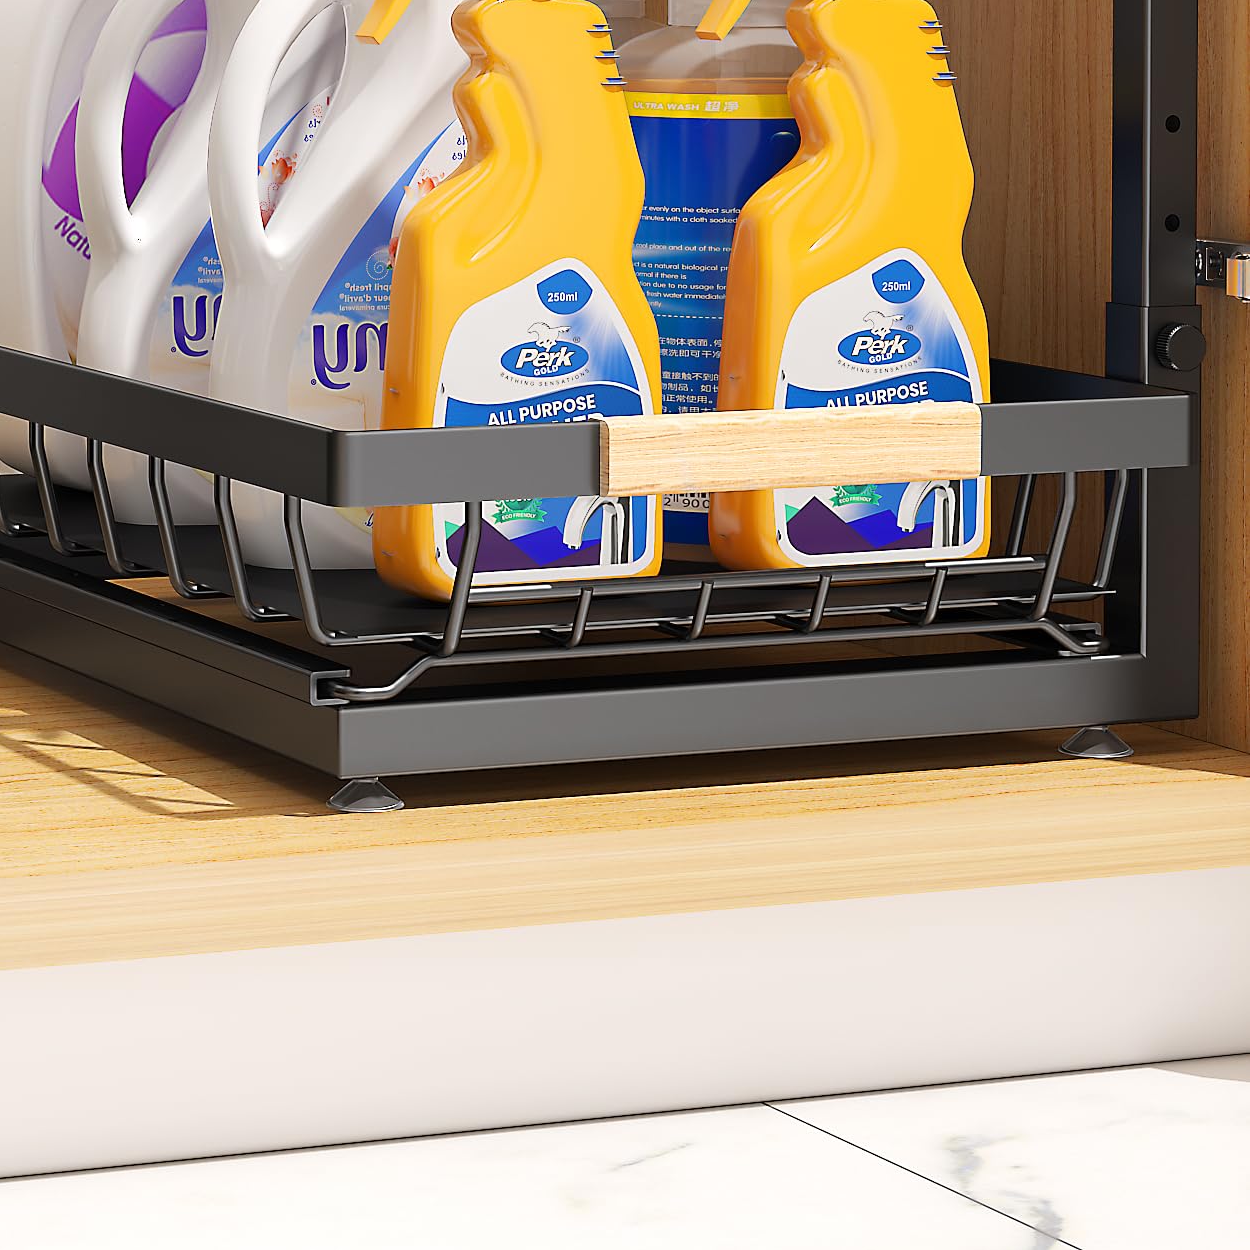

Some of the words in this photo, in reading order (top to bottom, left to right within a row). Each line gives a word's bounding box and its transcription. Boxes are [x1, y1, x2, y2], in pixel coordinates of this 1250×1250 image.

[633, 101, 664, 110] ULTRA
[667, 102, 699, 111] WASH
[648, 205, 669, 214] evenly
[695, 207, 719, 215] object
[649, 243, 667, 251] place
[654, 262, 680, 270] natural
[681, 263, 718, 271] biological
[881, 280, 911, 292] 250ml
[547, 291, 578, 303] 250ml
[851, 334, 909, 357] Perk
[516, 346, 575, 370] Perk
[868, 352, 893, 364] GOLD
[533, 364, 559, 377] GOLD
[873, 355, 923, 374] SENSATIONS
[538, 367, 591, 387] SENSATIONS
[855, 380, 929, 407] PURPOSE
[488, 409, 517, 426] ALL
[519, 393, 597, 423] PURPOSE
